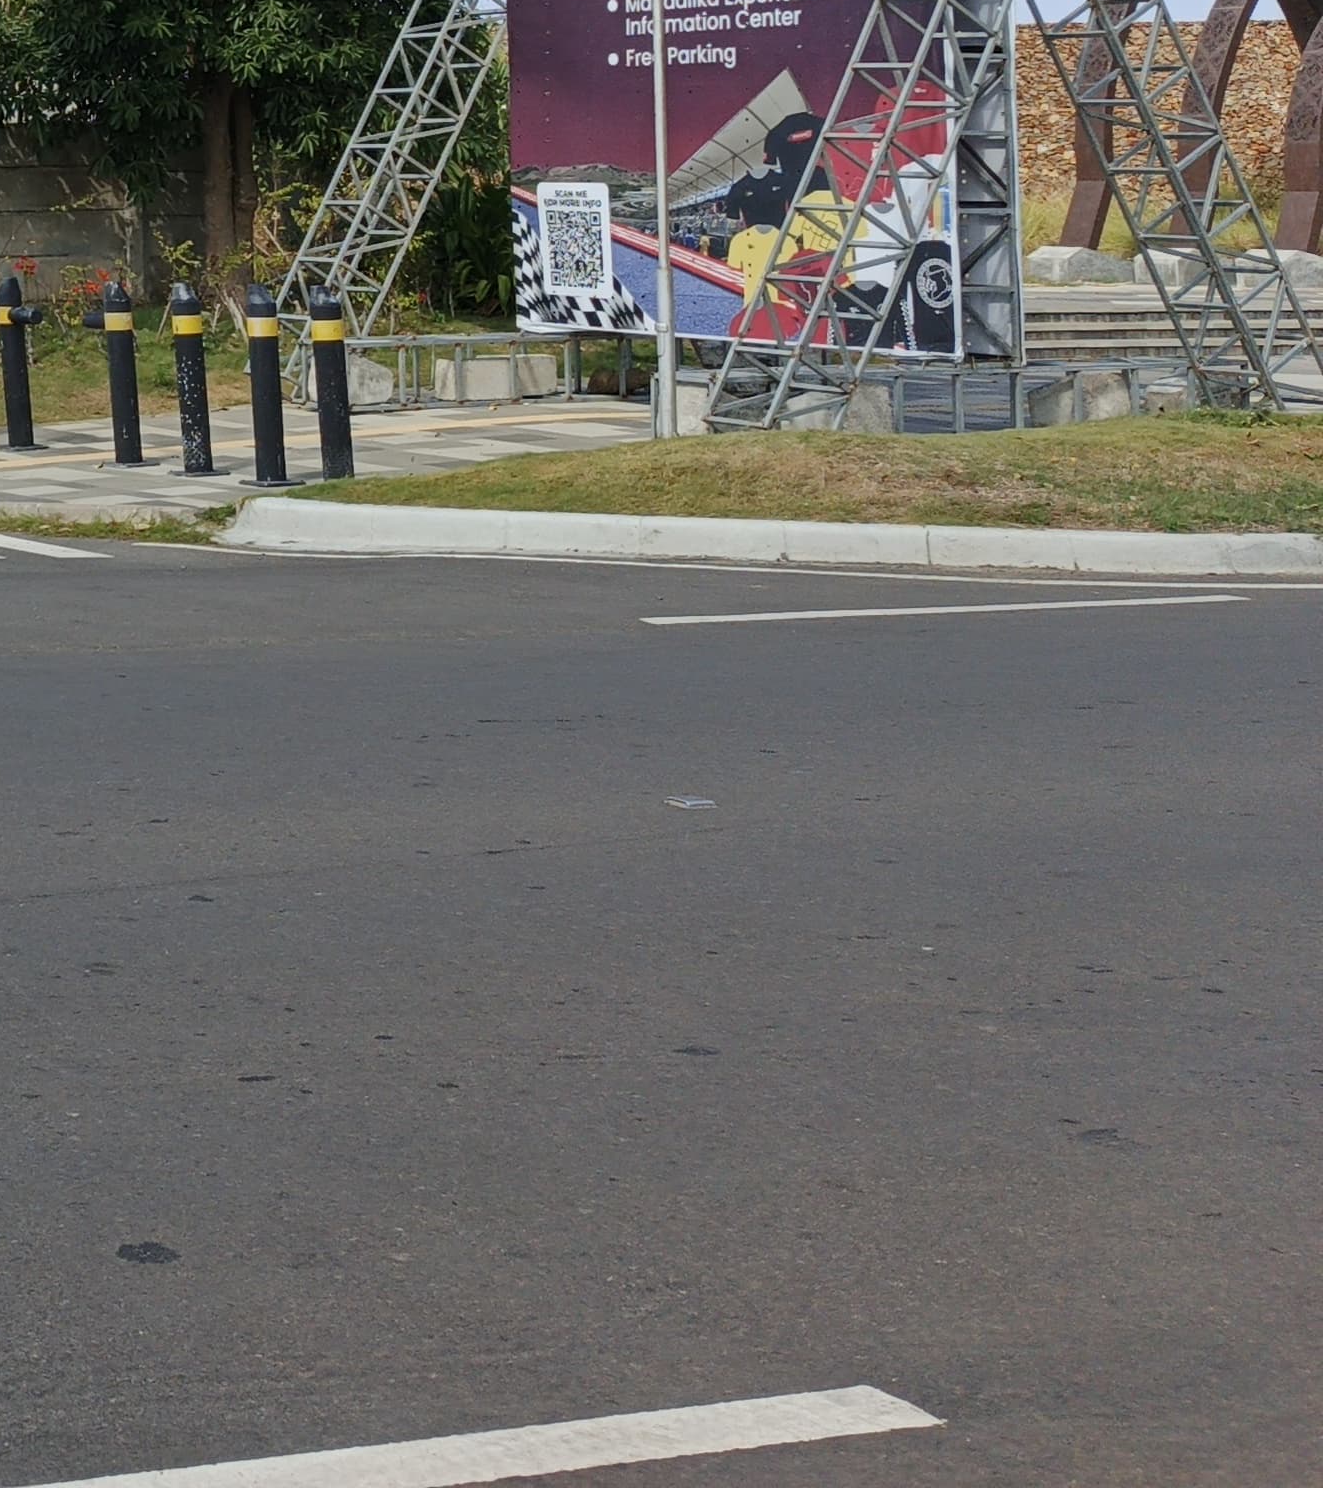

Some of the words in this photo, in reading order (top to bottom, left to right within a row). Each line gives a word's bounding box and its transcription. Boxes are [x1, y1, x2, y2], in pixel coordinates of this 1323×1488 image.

[625, 12, 731, 36] Infomation
[735, 9, 802, 29] Center
[625, 48, 655, 67] Fre
[667, 44, 737, 69] Parking
[554, 189, 573, 198] SCAN
[575, 190, 588, 198] ME
[559, 199, 580, 207] MORE
[582, 199, 602, 208] INFO
